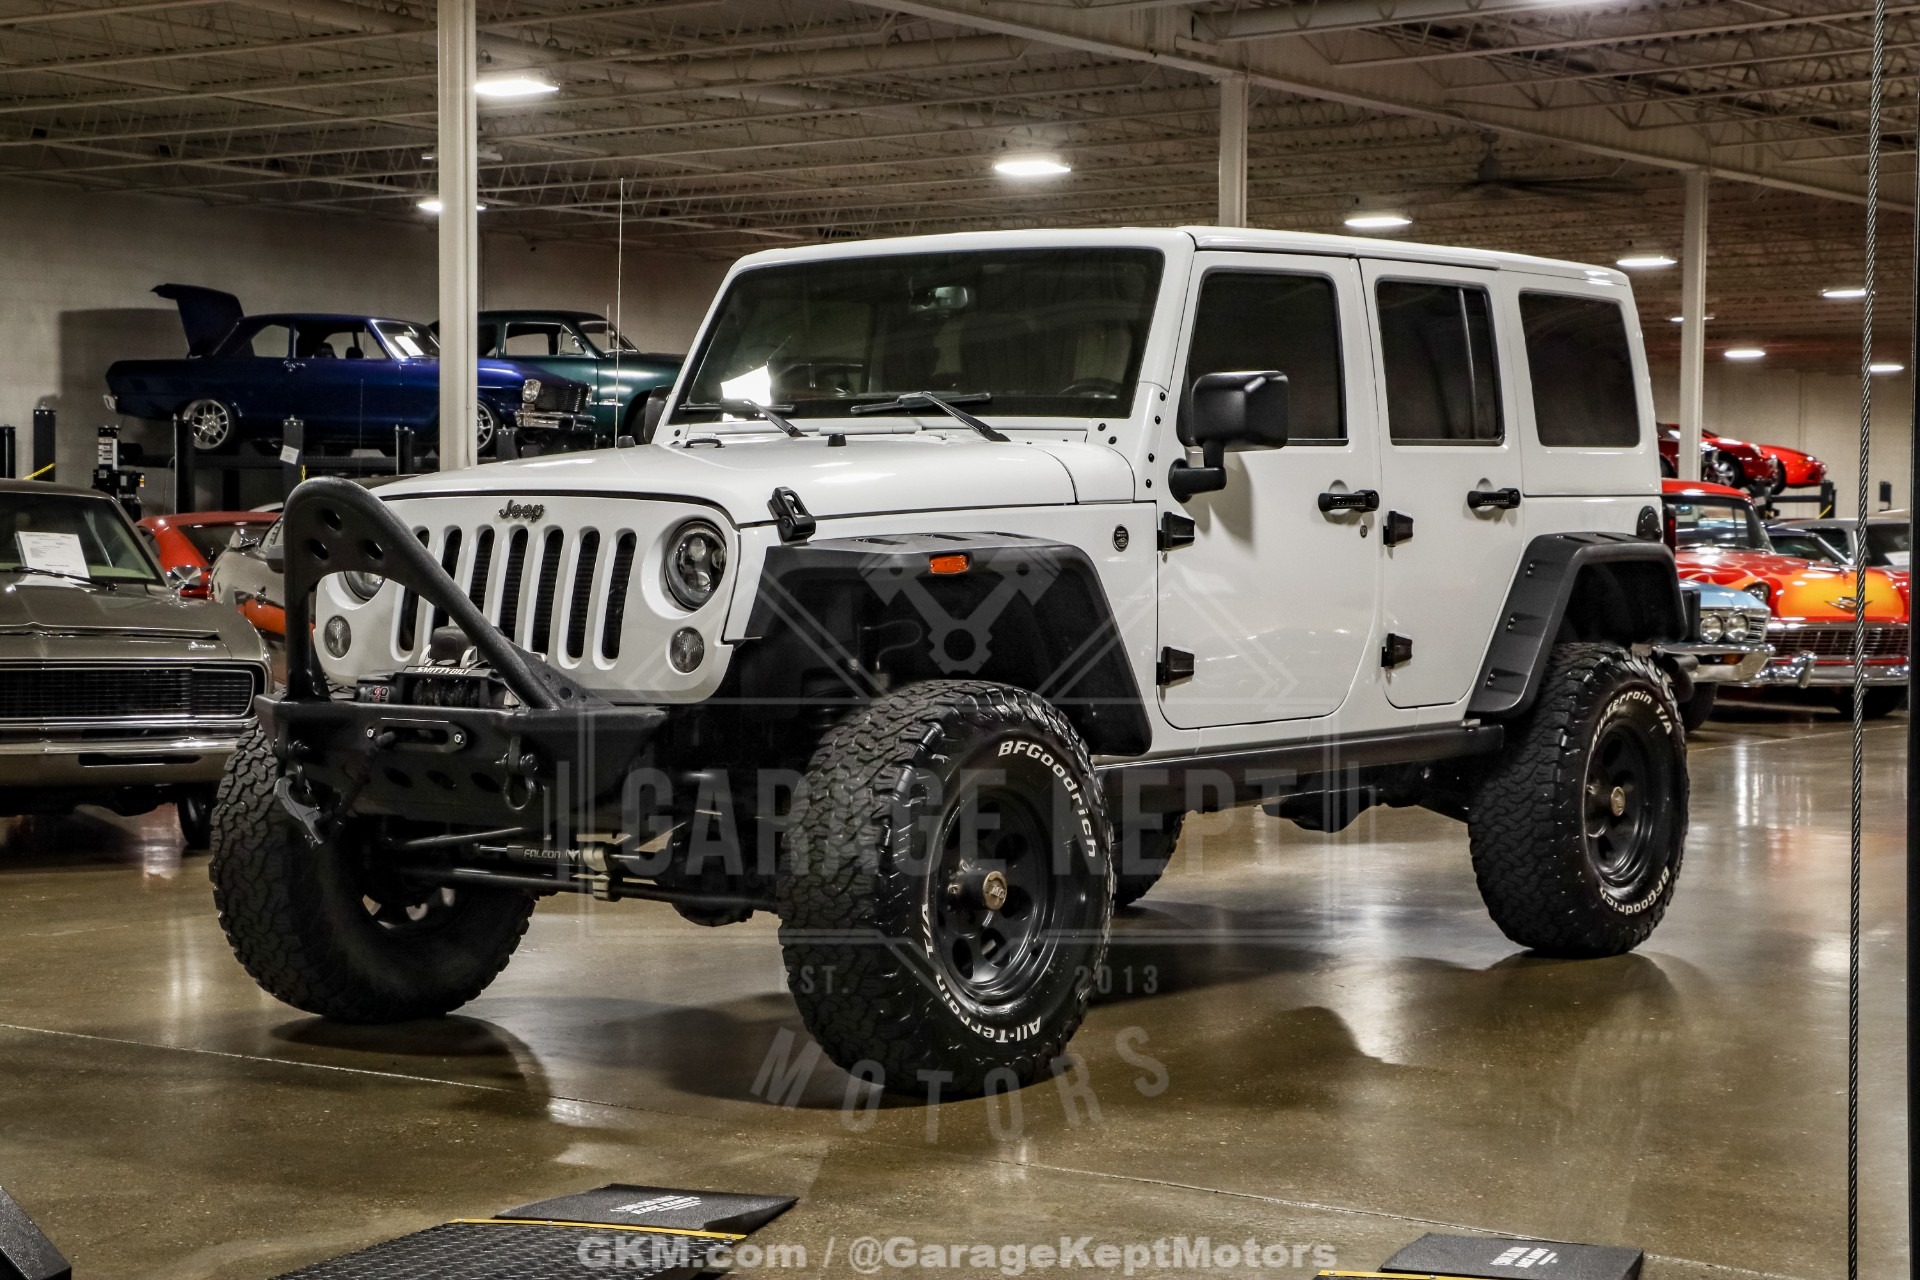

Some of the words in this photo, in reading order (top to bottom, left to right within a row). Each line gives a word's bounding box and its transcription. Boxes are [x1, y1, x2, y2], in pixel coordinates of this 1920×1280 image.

[498, 499, 545, 523] Jeep
[1656, 703, 1673, 735] T/A
[998, 740, 1096, 857] BFGoodrich
[523, 848, 561, 859] FALCON
[1600, 865, 1670, 916] BFGoodrich
[921, 903, 934, 959] T/A
[935, 973, 1042, 1043] All-Terrain
